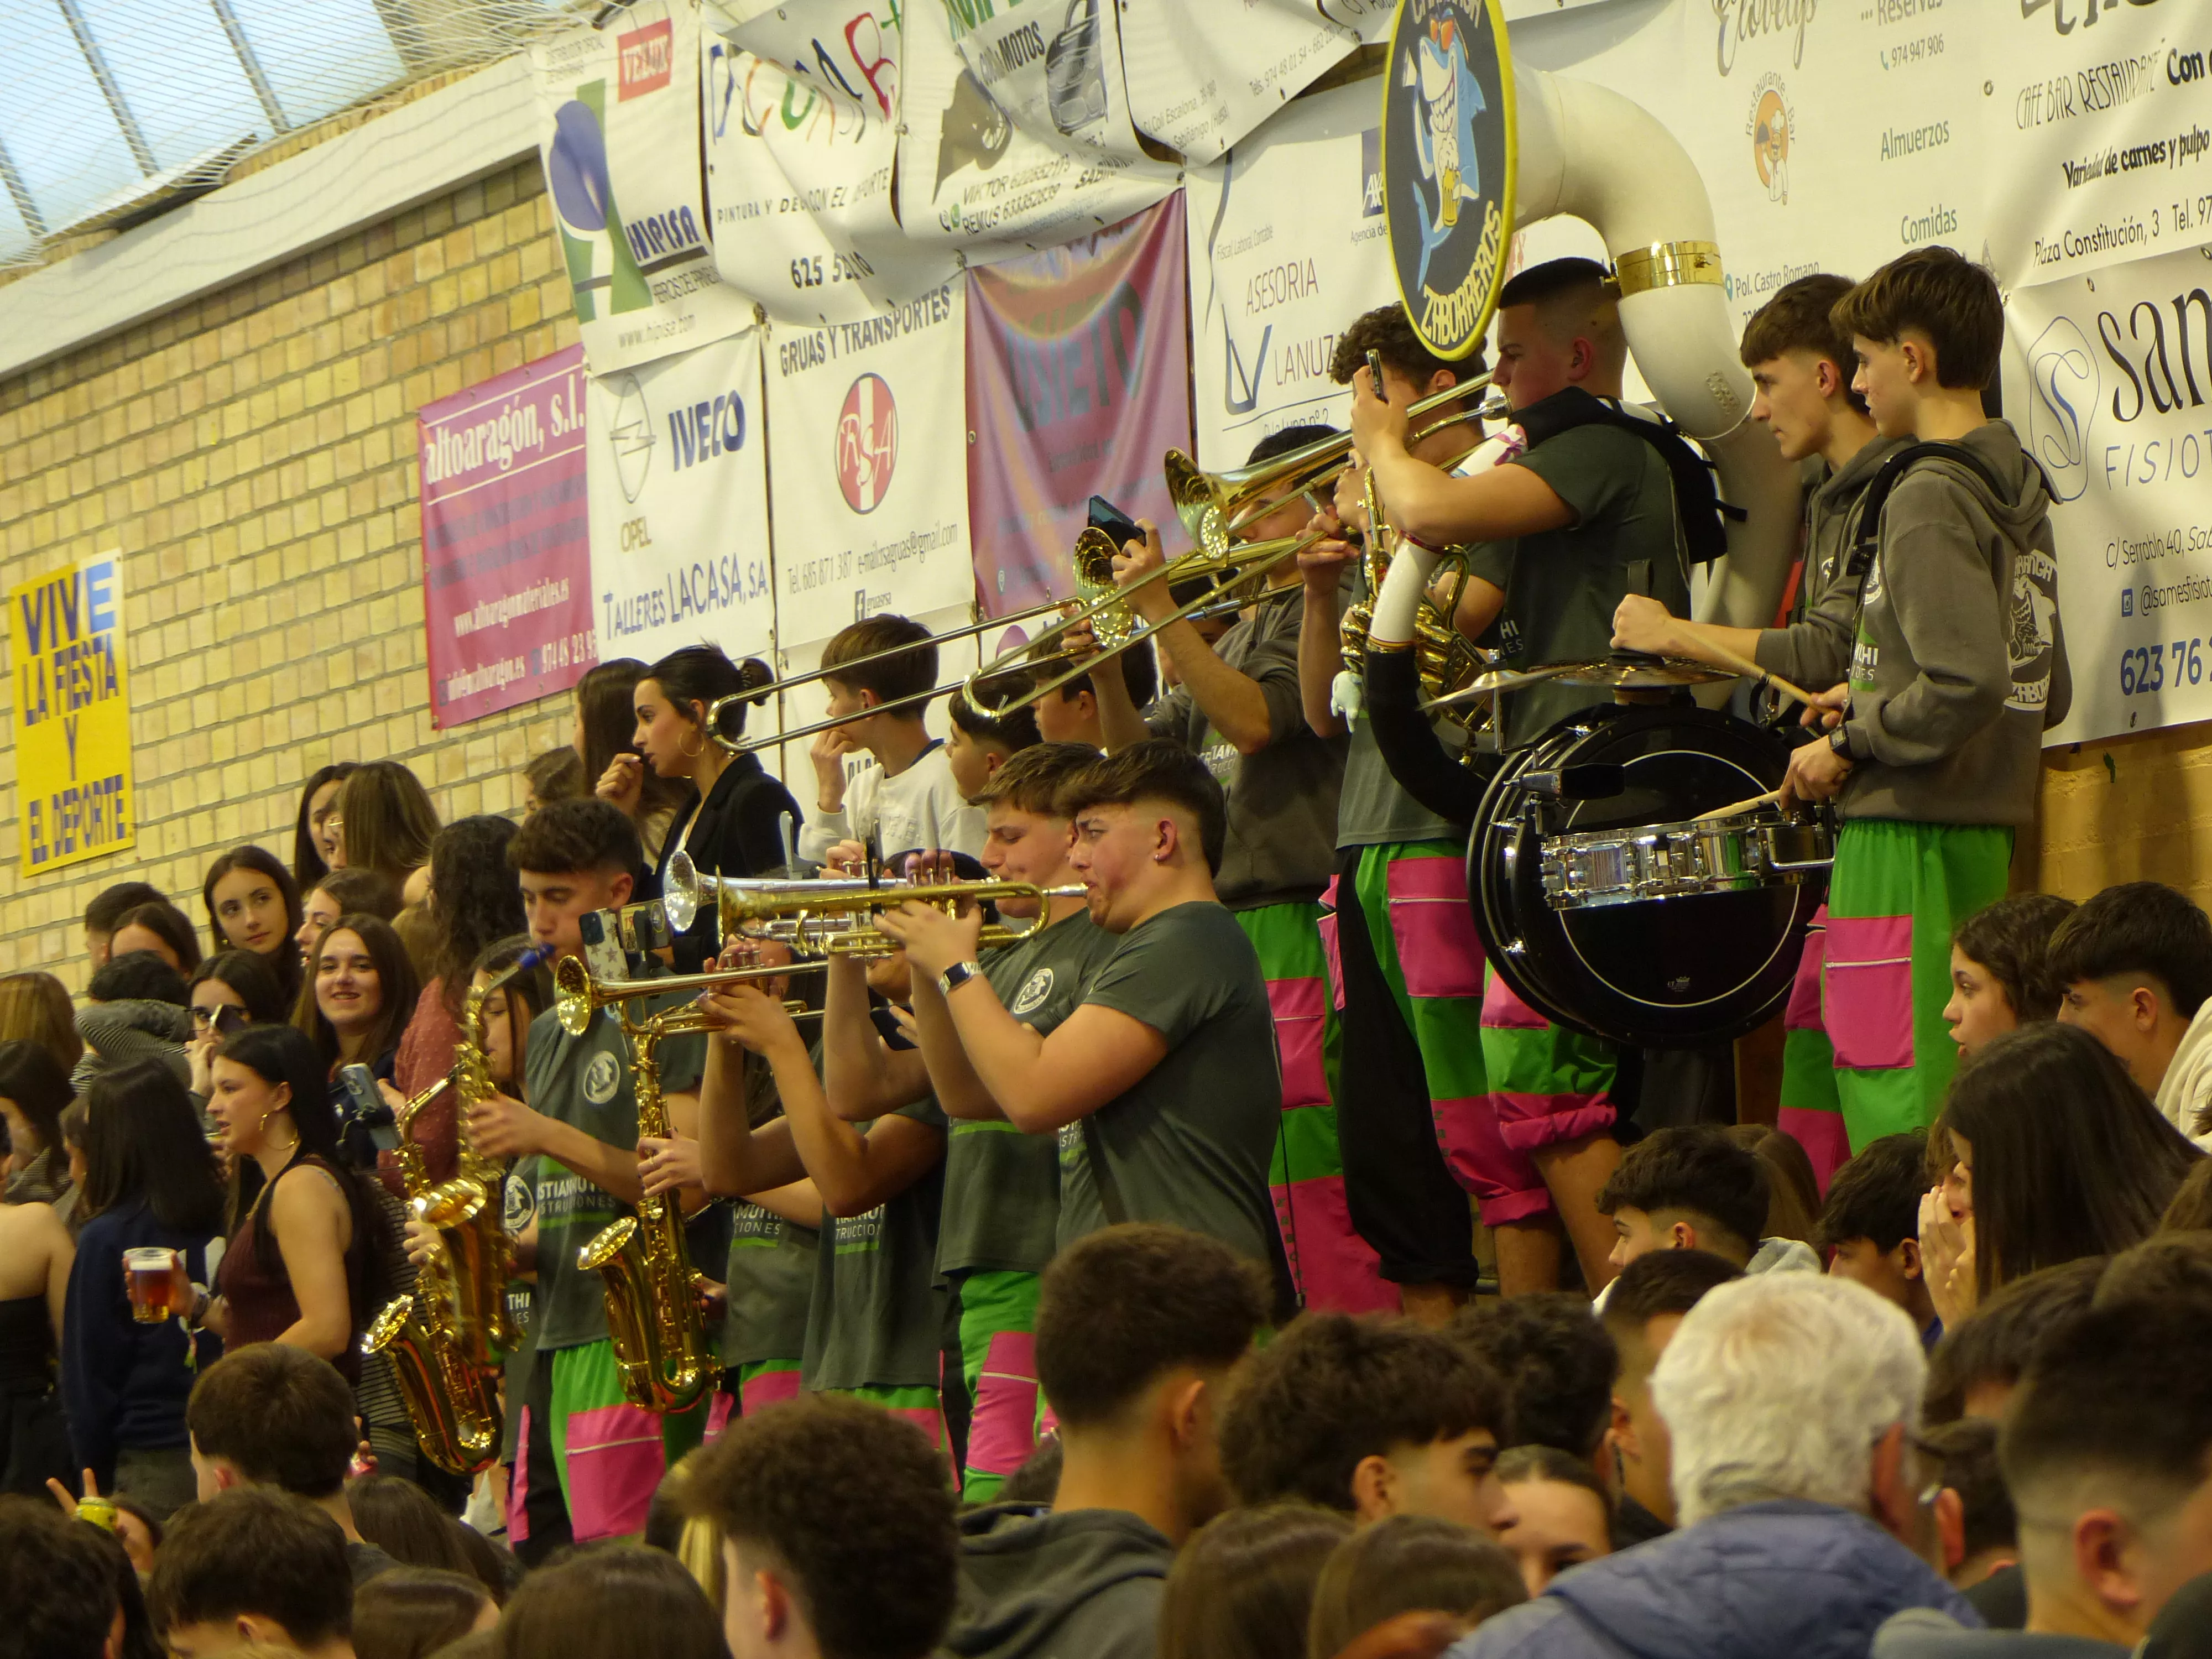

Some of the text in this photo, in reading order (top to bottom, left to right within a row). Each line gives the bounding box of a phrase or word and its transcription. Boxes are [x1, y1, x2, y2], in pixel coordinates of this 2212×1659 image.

[998, 20, 1045, 72] MOTOS
[1892, 33, 1944, 68] 974 947 906
[2167, 48, 2205, 86] Con
[1745, 71, 1785, 137] Restaurante
[1787, 106, 1796, 145] Bar
[2016, 83, 2043, 129] CAFE
[2047, 76, 2077, 122] BAR
[1880, 119, 1950, 161] Almuerzos
[2105, 145, 2119, 176] de
[2121, 140, 2166, 171] carnes
[2168, 138, 2177, 170] y
[2179, 123, 2210, 167] pulpo
[717, 201, 760, 224] PINTURA
[765, 199, 773, 215] Y
[962, 205, 1001, 236] REMUS
[1350, 222, 1387, 247] Agencia de
[1901, 204, 1958, 245] Comidas
[2033, 237, 2062, 268] Plaza
[2064, 215, 2148, 258] Constitución,
[2152, 208, 2160, 238] 3
[2172, 199, 2193, 232] Tel.
[791, 255, 823, 289] 625
[1246, 258, 1319, 317] ASESORIA
[1421, 201, 1501, 346] ZABORREROS
[1735, 261, 1819, 298] Pol. Castro Romano
[780, 285, 951, 377] GRUAS Y TRANSPORTES
[1275, 335, 1334, 386] LANUZ
[425, 373, 585, 485] altoaragón, s.l.
[668, 389, 746, 472] IVECO
[620, 515, 651, 552] OPEL
[2106, 536, 2120, 570] C/
[2122, 531, 2164, 565] Serrablo
[2167, 528, 2185, 558] 40,
[603, 589, 666, 640] TALLERES
[667, 552, 747, 624] LACASA,
[787, 564, 801, 594] Tel.
[802, 561, 816, 591] 685
[819, 556, 834, 585] 871
[837, 550, 853, 581] 387
[21, 561, 116, 656] VIVE
[23, 633, 119, 726] LA FIESTA
[2120, 638, 2203, 696] 623 76
[64, 714, 78, 781] Y
[29, 774, 125, 864] EL DEPORTE
